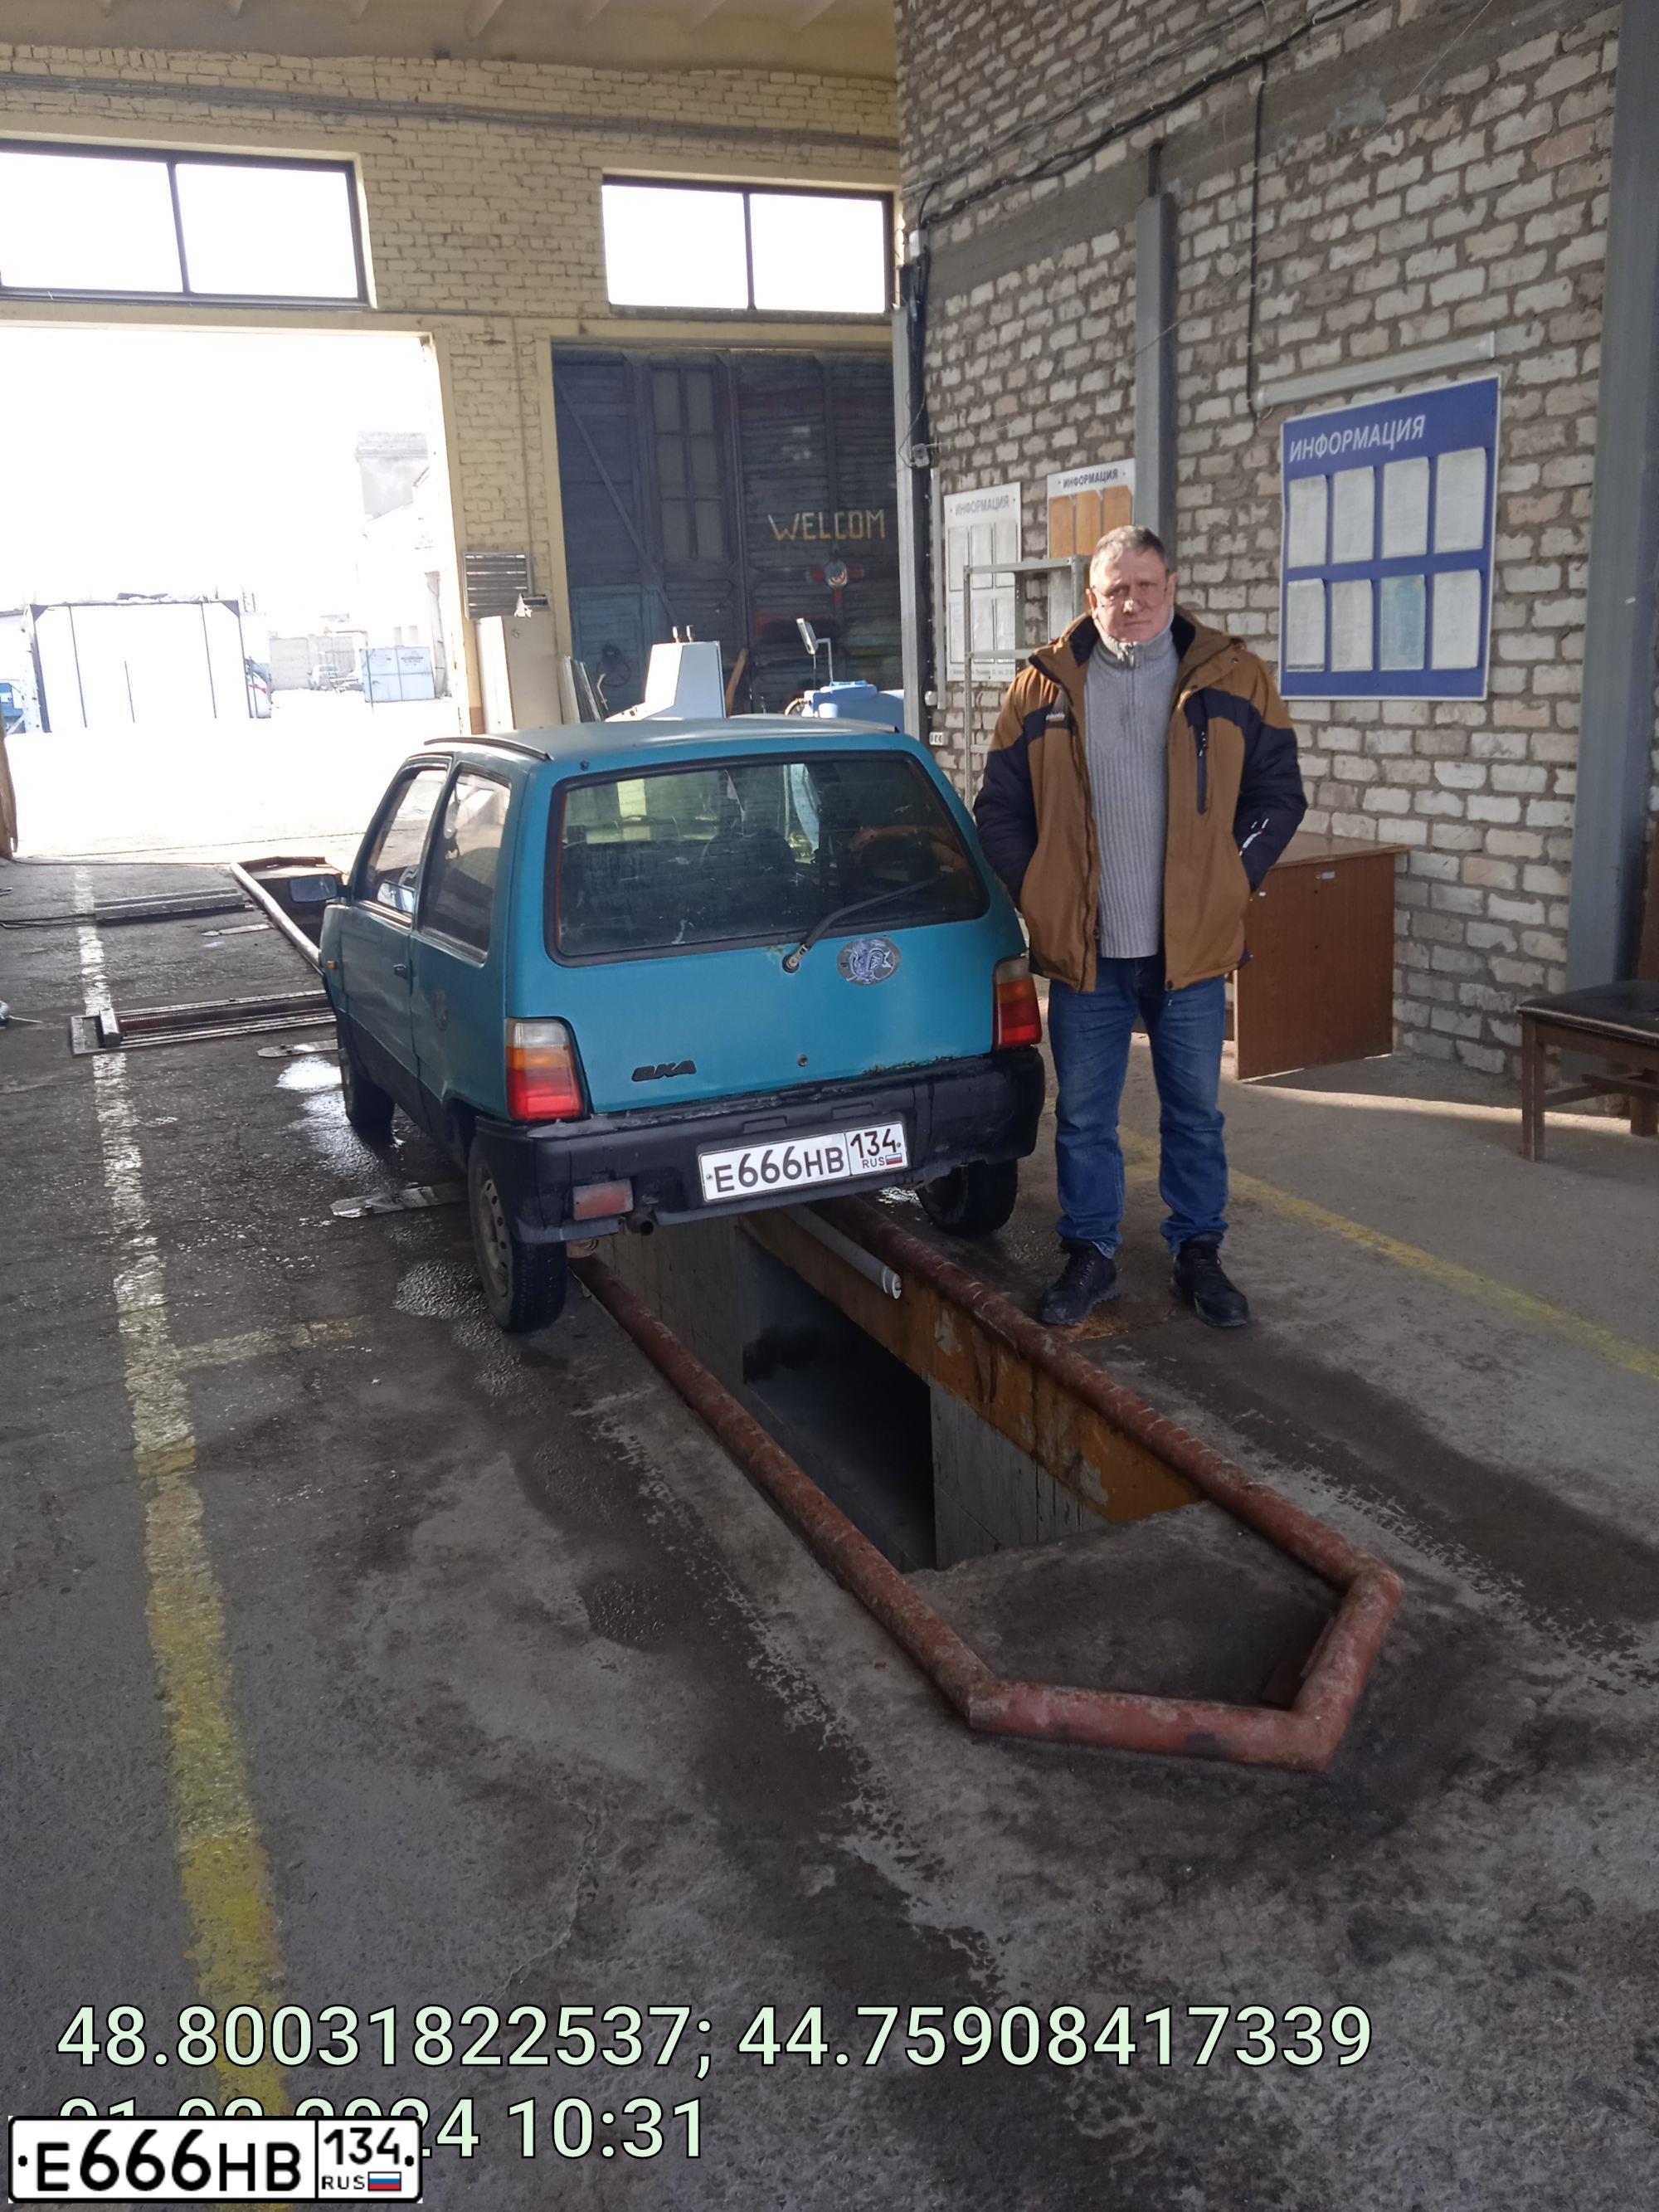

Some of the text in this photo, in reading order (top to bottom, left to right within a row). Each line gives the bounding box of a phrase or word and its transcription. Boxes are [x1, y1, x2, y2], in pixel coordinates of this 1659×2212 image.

[1289, 414, 1426, 463] ИНФОРМАЦИЯ
[1063, 468, 1119, 489] ИНФОРМАЦИЯ
[954, 495, 1010, 516] ИНФОРМАЦИЯ
[767, 509, 886, 541] WELCOM
[713, 1128, 898, 1193] Е666НВ 134
[862, 1157, 886, 1169] RUS
